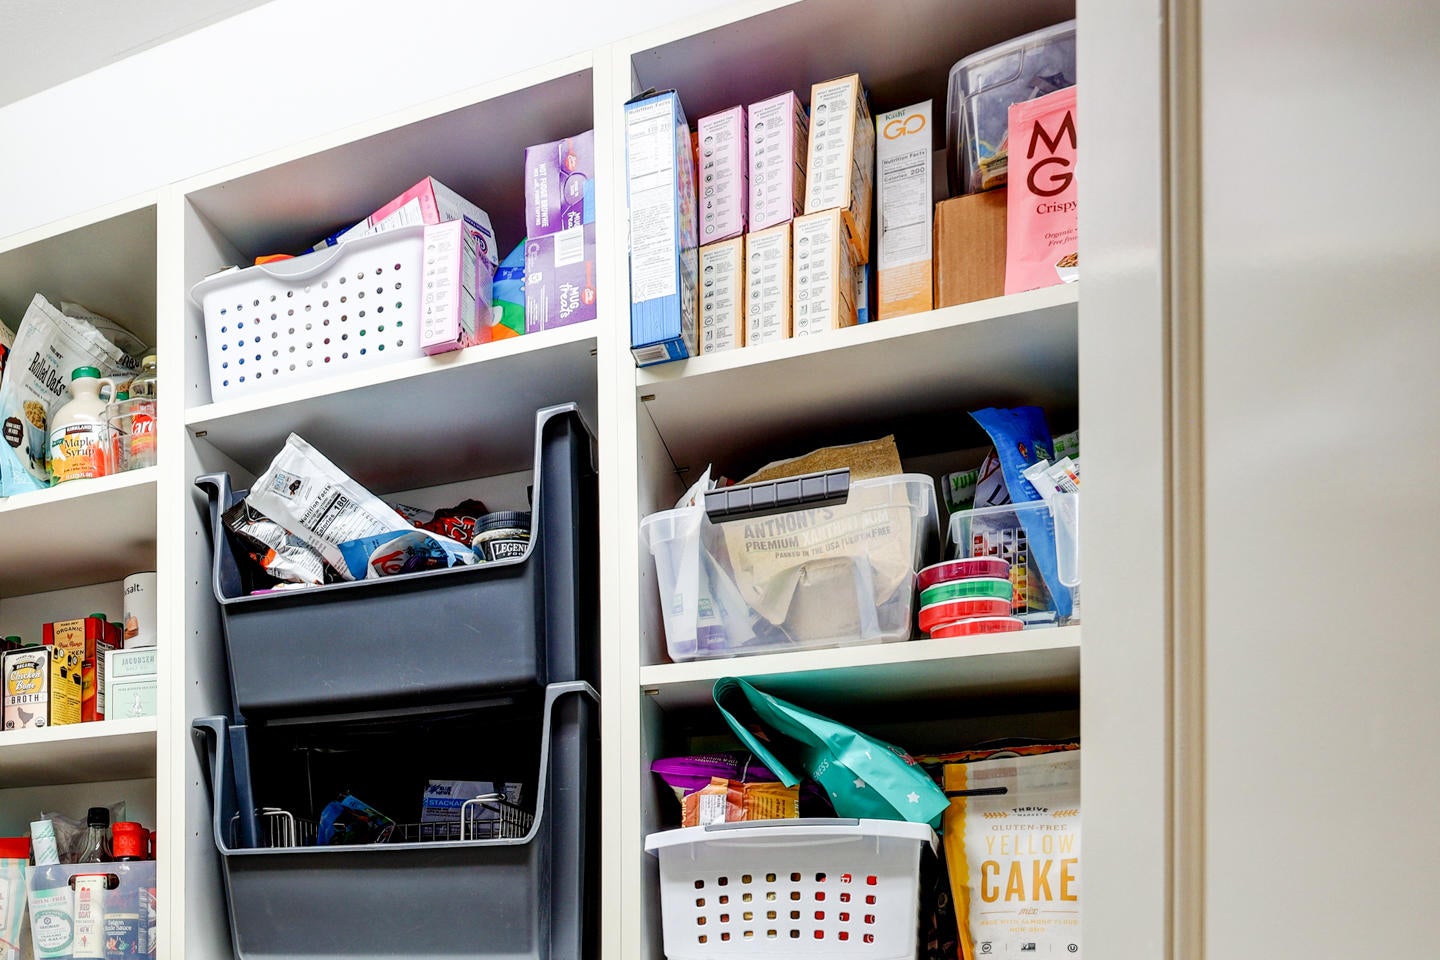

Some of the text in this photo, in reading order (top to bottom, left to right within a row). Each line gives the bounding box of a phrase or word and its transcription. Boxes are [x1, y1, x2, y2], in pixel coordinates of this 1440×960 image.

[910, 167, 925, 175] 200
[1036, 201, 1077, 214] Crispy
[570, 286, 579, 310] MUG
[28, 351, 67, 397] Rolled Oats
[64, 437, 94, 448] Maple
[66, 447, 95, 458] Syrup
[299, 498, 319, 524] Nutrition
[333, 496, 348, 512] 180
[744, 508, 834, 539] ANTHONY'S
[745, 537, 799, 552] PREMIUM
[812, 541, 840, 556] THE USA
[10, 670, 40, 681] Chicken
[16, 680, 35, 691] Bone
[11, 695, 40, 704] BROTH
[985, 833, 1075, 856] YELLOW
[981, 858, 1078, 903] CAKE
